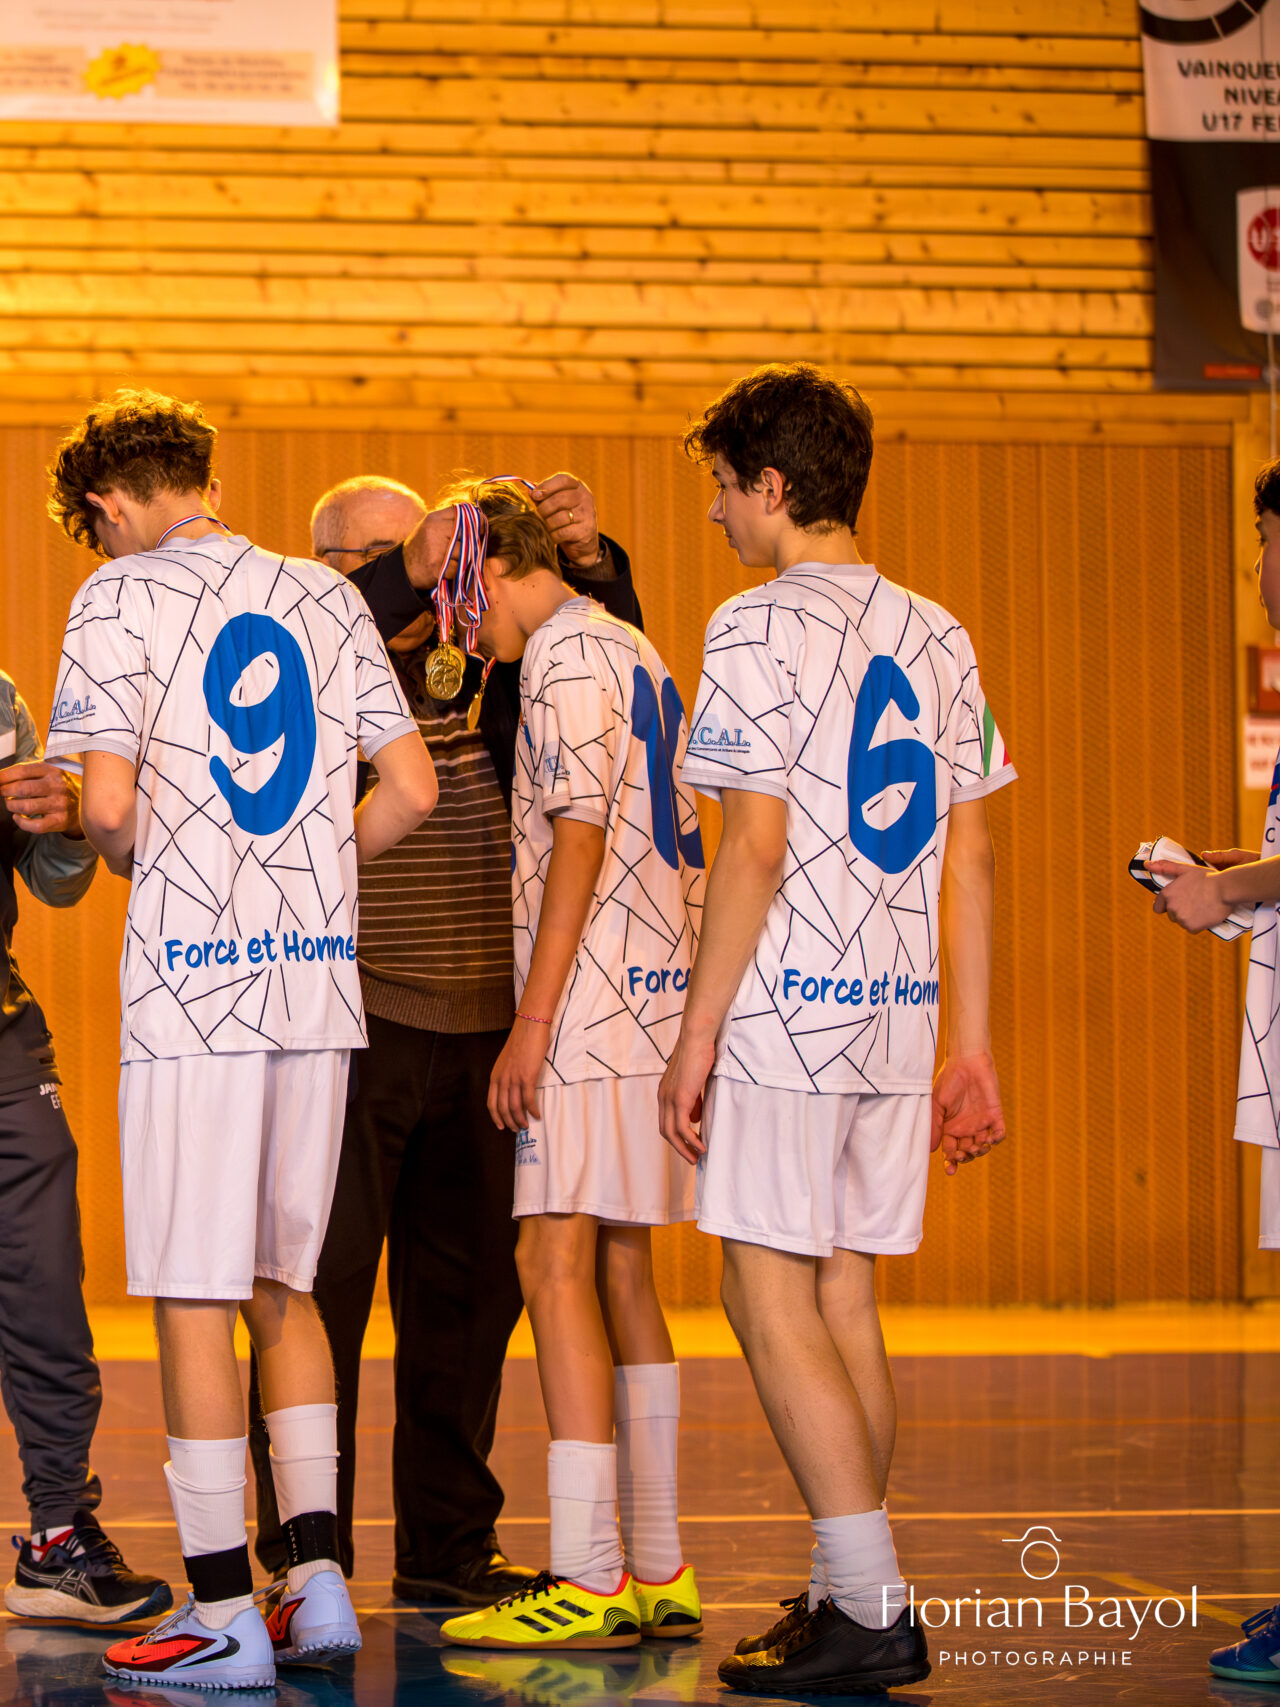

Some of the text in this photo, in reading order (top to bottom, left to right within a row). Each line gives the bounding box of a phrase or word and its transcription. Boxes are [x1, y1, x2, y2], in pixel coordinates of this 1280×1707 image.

[1177, 60, 1280, 80] VAINQUE
[1224, 87, 1280, 106] NIVE
[1202, 111, 1280, 133] U17 FE
[202, 611, 317, 837] 9
[847, 655, 937, 875] 6
[164, 939, 240, 972] Force
[247, 928, 278, 964] et
[783, 968, 864, 1006] Force
[870, 971, 890, 1006] et
